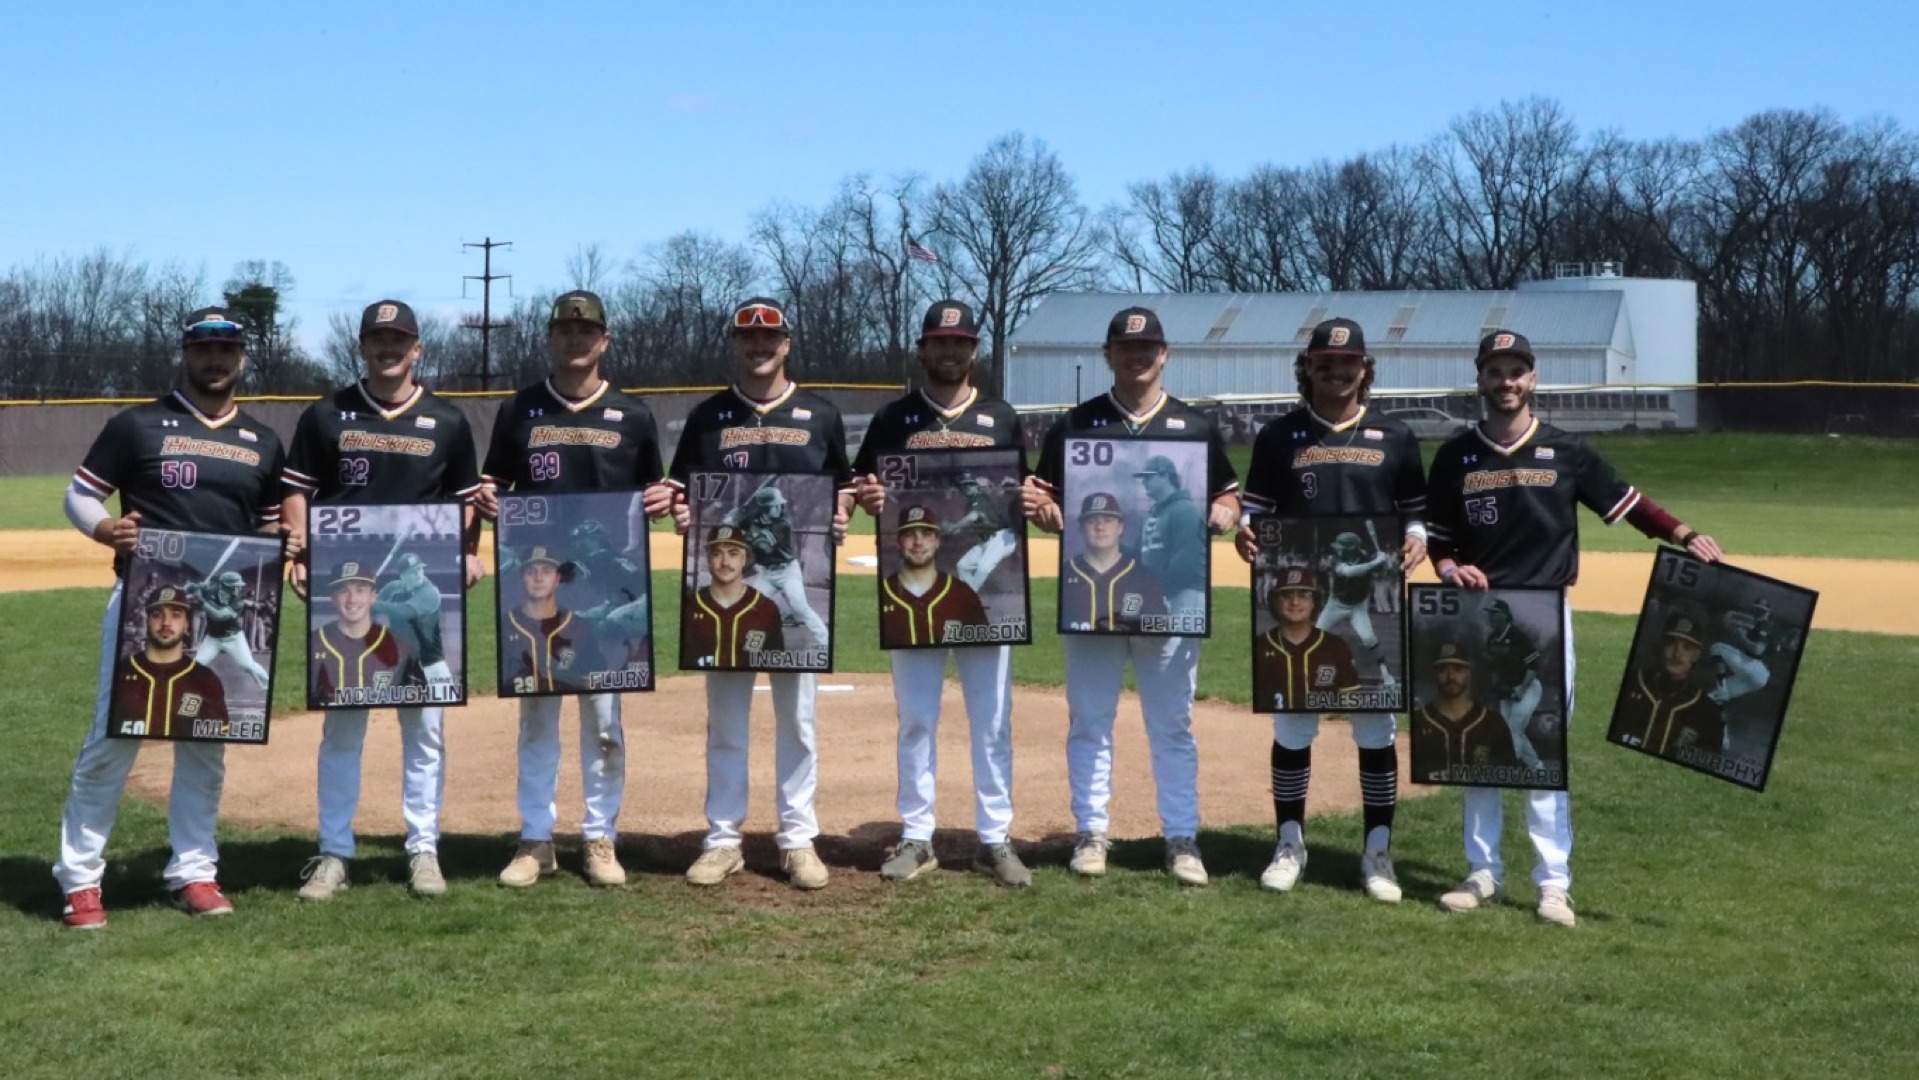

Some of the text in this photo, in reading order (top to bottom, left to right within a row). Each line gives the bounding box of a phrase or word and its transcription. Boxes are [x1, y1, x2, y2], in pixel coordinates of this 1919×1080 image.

[339, 430, 436, 456] HUSKIES
[528, 425, 621, 448] HUSKIES
[718, 426, 811, 450] HUSKIES
[159, 435, 260, 467] HUSKIES
[1071, 442, 1114, 467] 30
[1291, 446, 1385, 469] HUSKIES
[161, 461, 197, 489] 50
[340, 458, 370, 486] 22
[529, 451, 560, 481] 29
[883, 455, 919, 482] 21
[695, 473, 731, 501] 17
[1301, 472, 1319, 500] 3
[1463, 468, 1557, 494] HUSKIES
[318, 508, 361, 534] 22
[502, 496, 549, 526] 29
[1465, 496, 1500, 525] 55
[136, 530, 185, 560] 50
[1259, 519, 1282, 547] 3
[1664, 556, 1701, 588] 15
[1418, 591, 1460, 616] 55
[1141, 614, 1206, 633] PEIFER
[749, 650, 829, 669] INGALLS
[514, 677, 535, 693] 29
[589, 670, 650, 690] FLURY
[333, 683, 464, 706] MCLAUGHLIN
[120, 720, 145, 735] 50
[193, 718, 264, 740] MILLER
[1678, 744, 1764, 783] MURPHY
